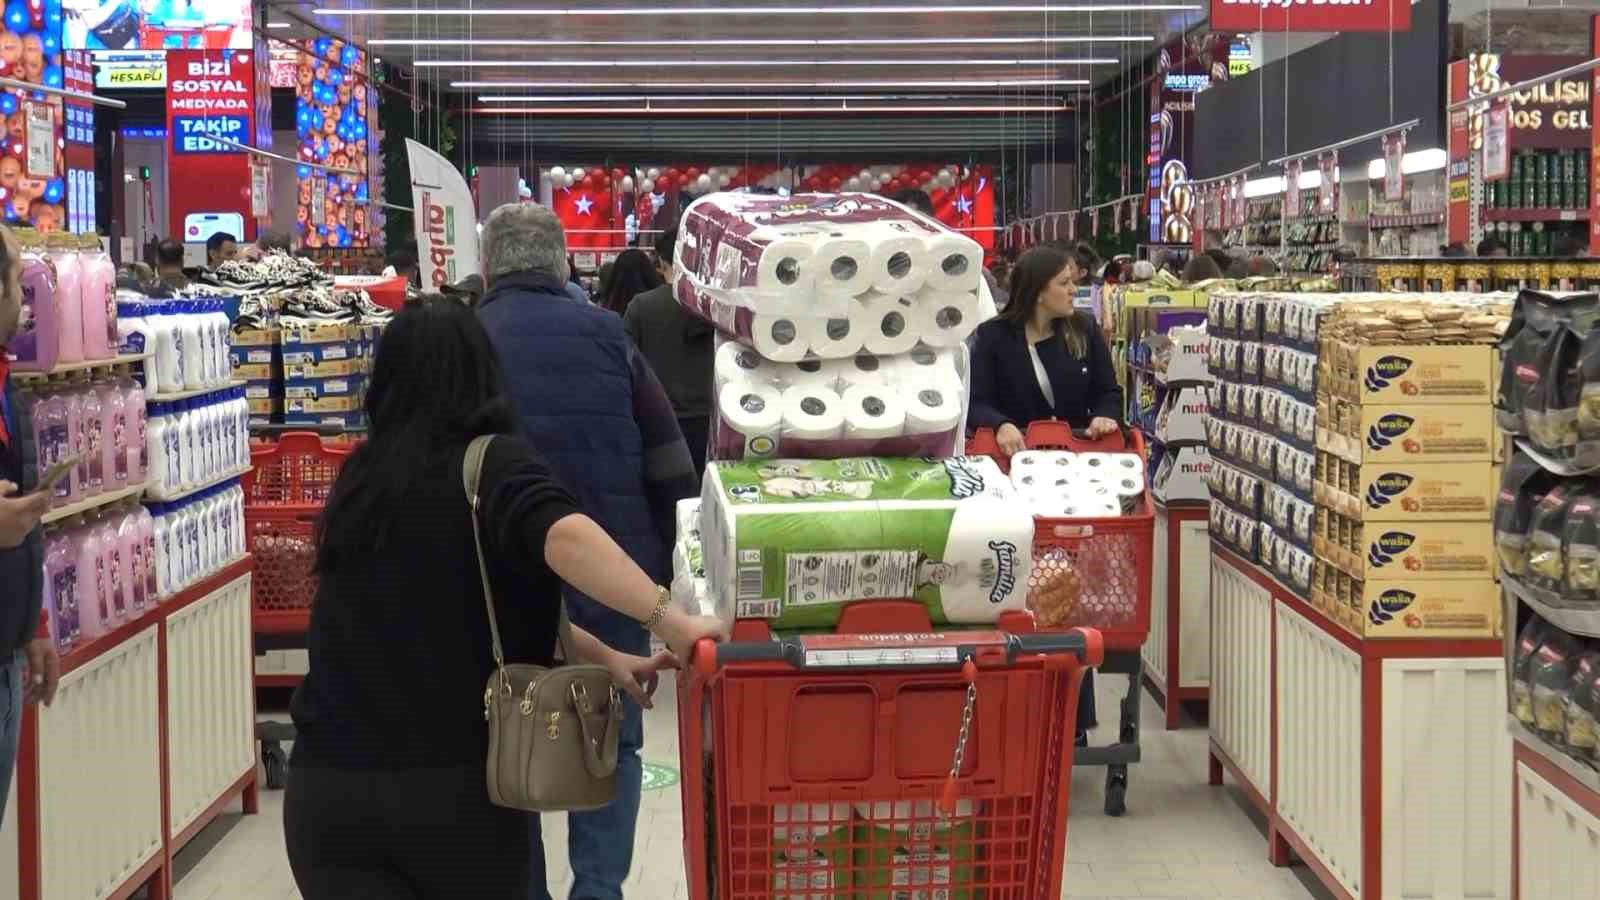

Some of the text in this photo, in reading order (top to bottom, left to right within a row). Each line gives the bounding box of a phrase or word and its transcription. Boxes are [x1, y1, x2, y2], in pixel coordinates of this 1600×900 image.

[188, 59, 231, 76] BİZİ
[110, 72, 163, 82] HESAPLI
[172, 80, 248, 92] SOSYAL
[172, 99, 248, 109] MEDYADA
[180, 116, 241, 133] TAKİP
